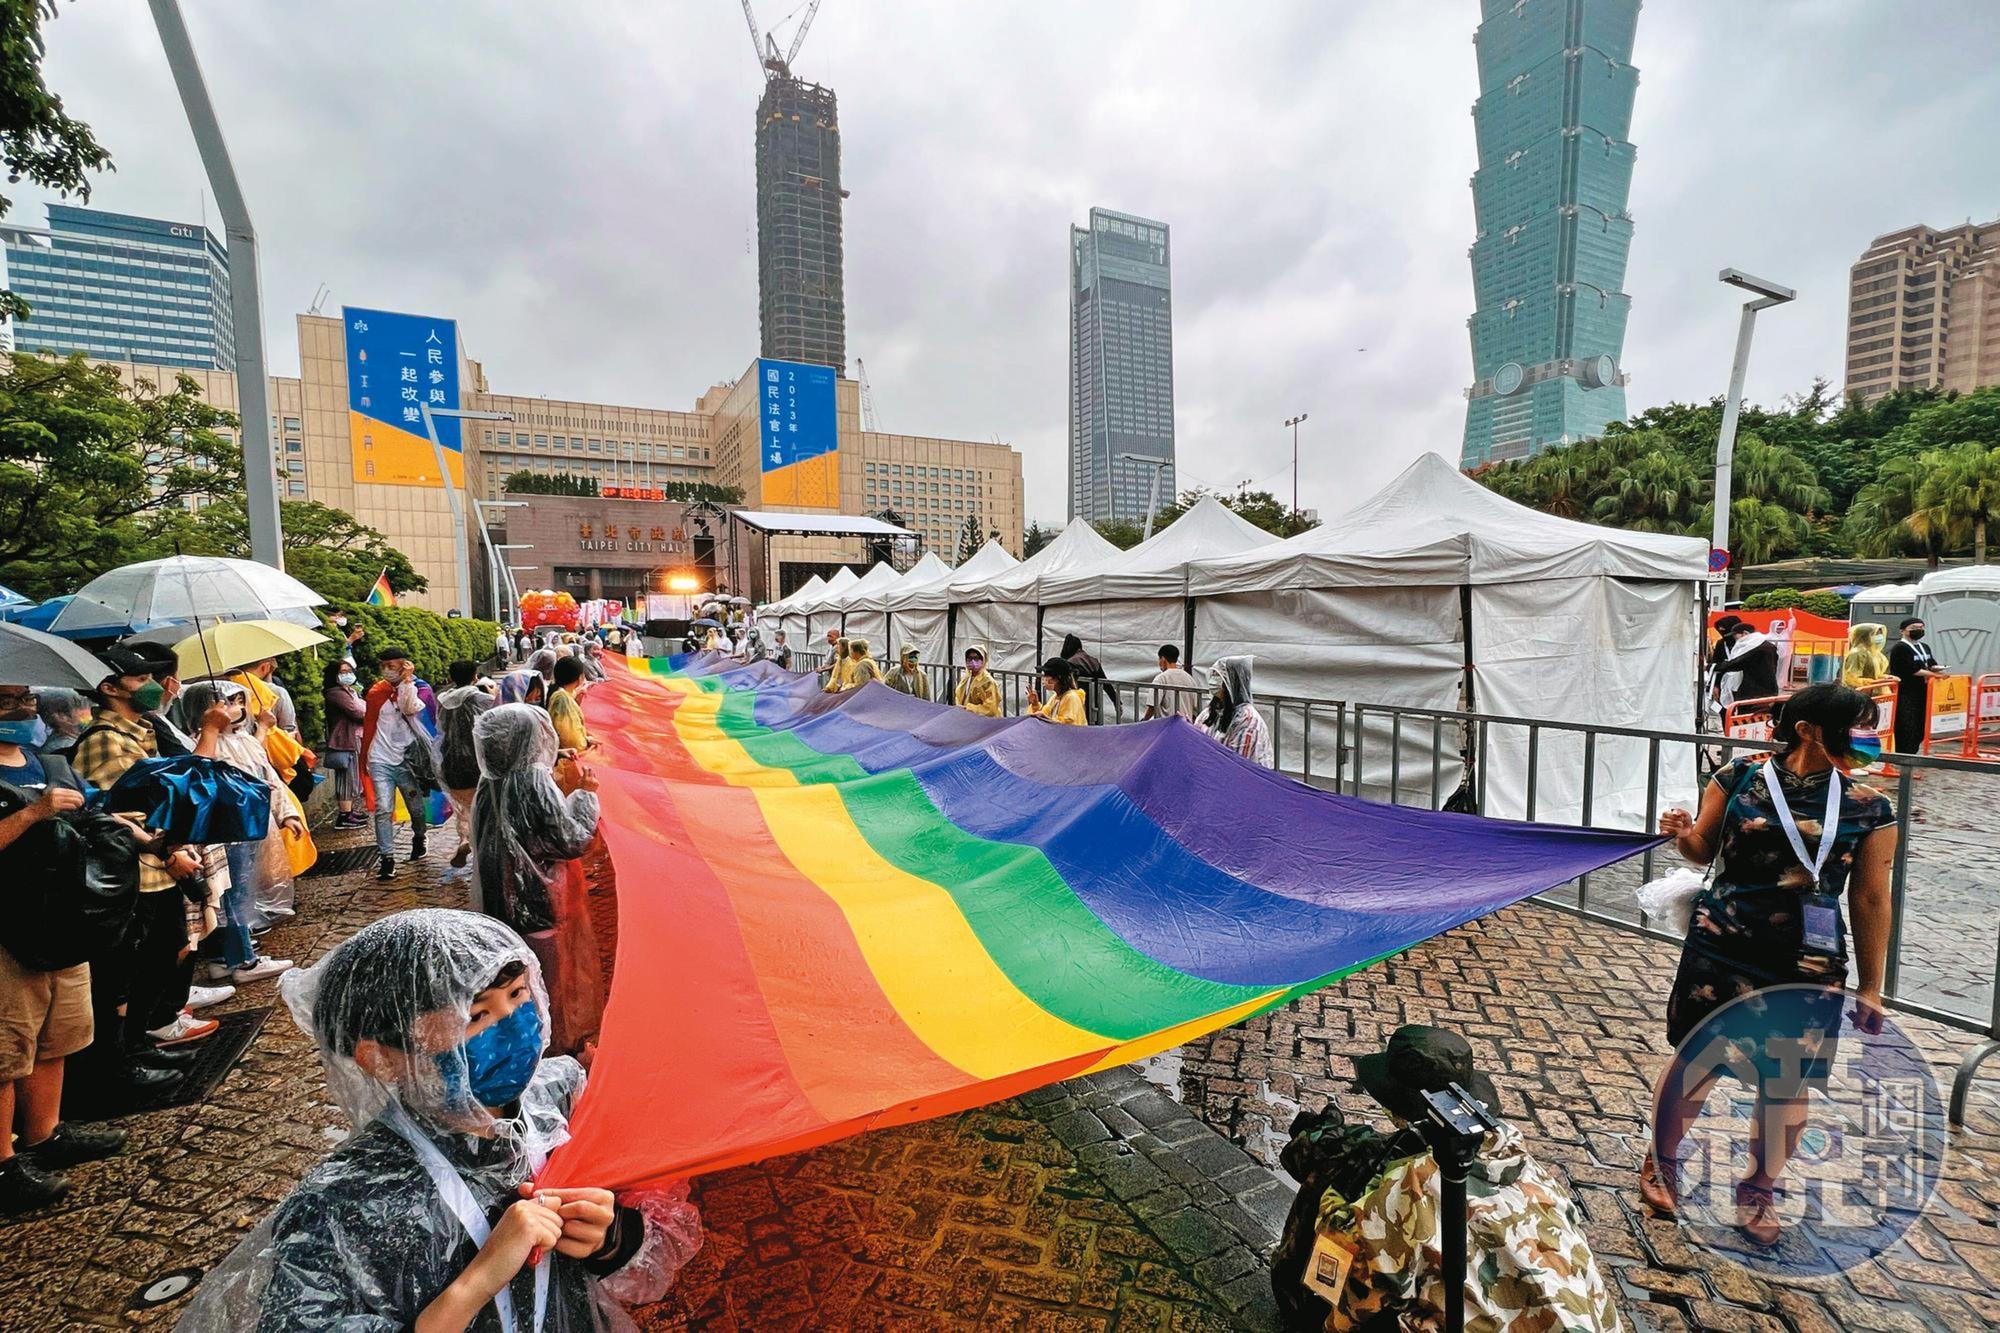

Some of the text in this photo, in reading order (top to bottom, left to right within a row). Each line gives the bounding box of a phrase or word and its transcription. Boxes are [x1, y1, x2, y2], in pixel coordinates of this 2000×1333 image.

[170, 226, 193, 238] citi
[399, 351, 420, 423] 一起改變
[425, 328, 446, 405] 人民參與
[767, 369, 783, 464] 國民法官上場
[788, 371, 798, 433] 2023年
[581, 540, 618, 550] TAIPEI
[627, 541, 653, 552] CITY
